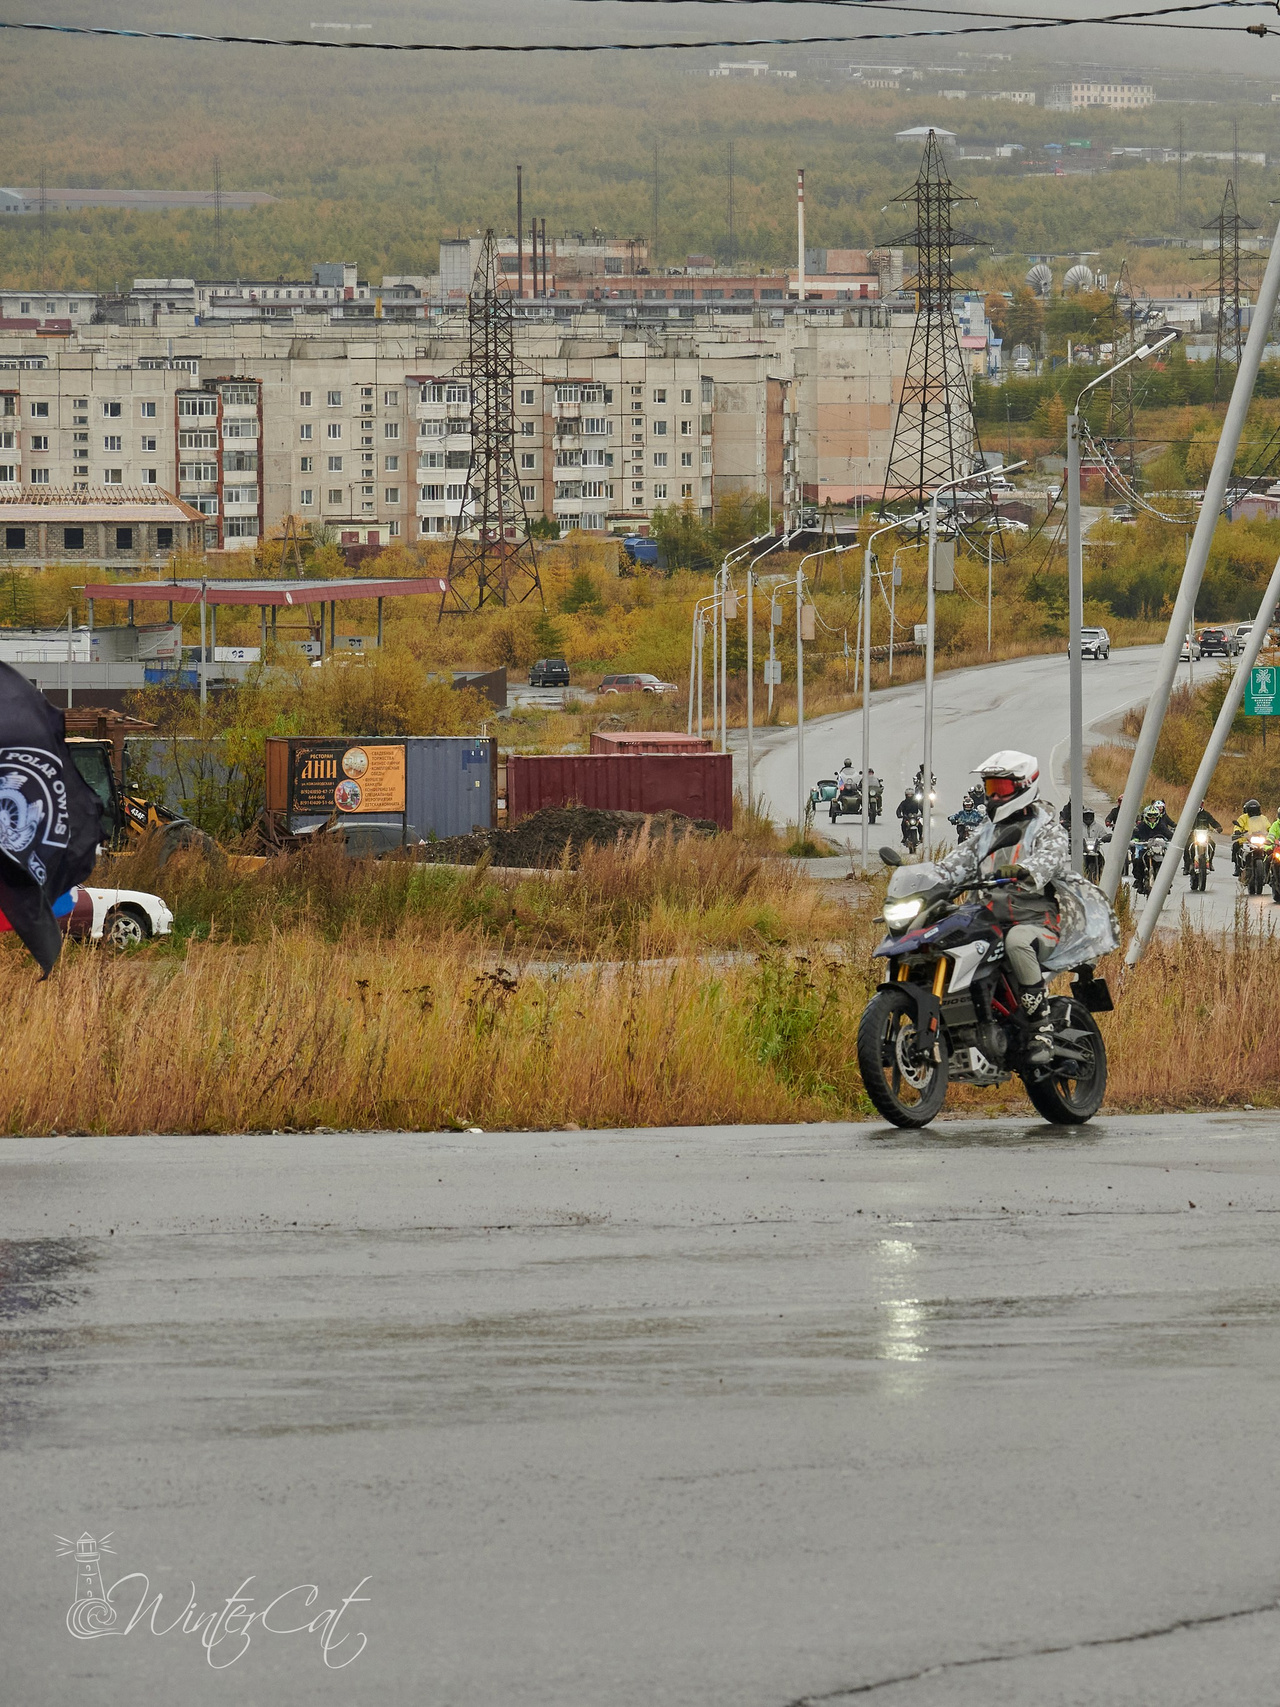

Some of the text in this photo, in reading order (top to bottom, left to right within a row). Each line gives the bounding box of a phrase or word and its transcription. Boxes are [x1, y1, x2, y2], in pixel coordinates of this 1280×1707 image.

[231, 650, 244, 659] 92
[301, 760, 337, 779] АНИ
[5, 752, 70, 835] POLAR OWLS
[29, 856, 46, 881] MC
